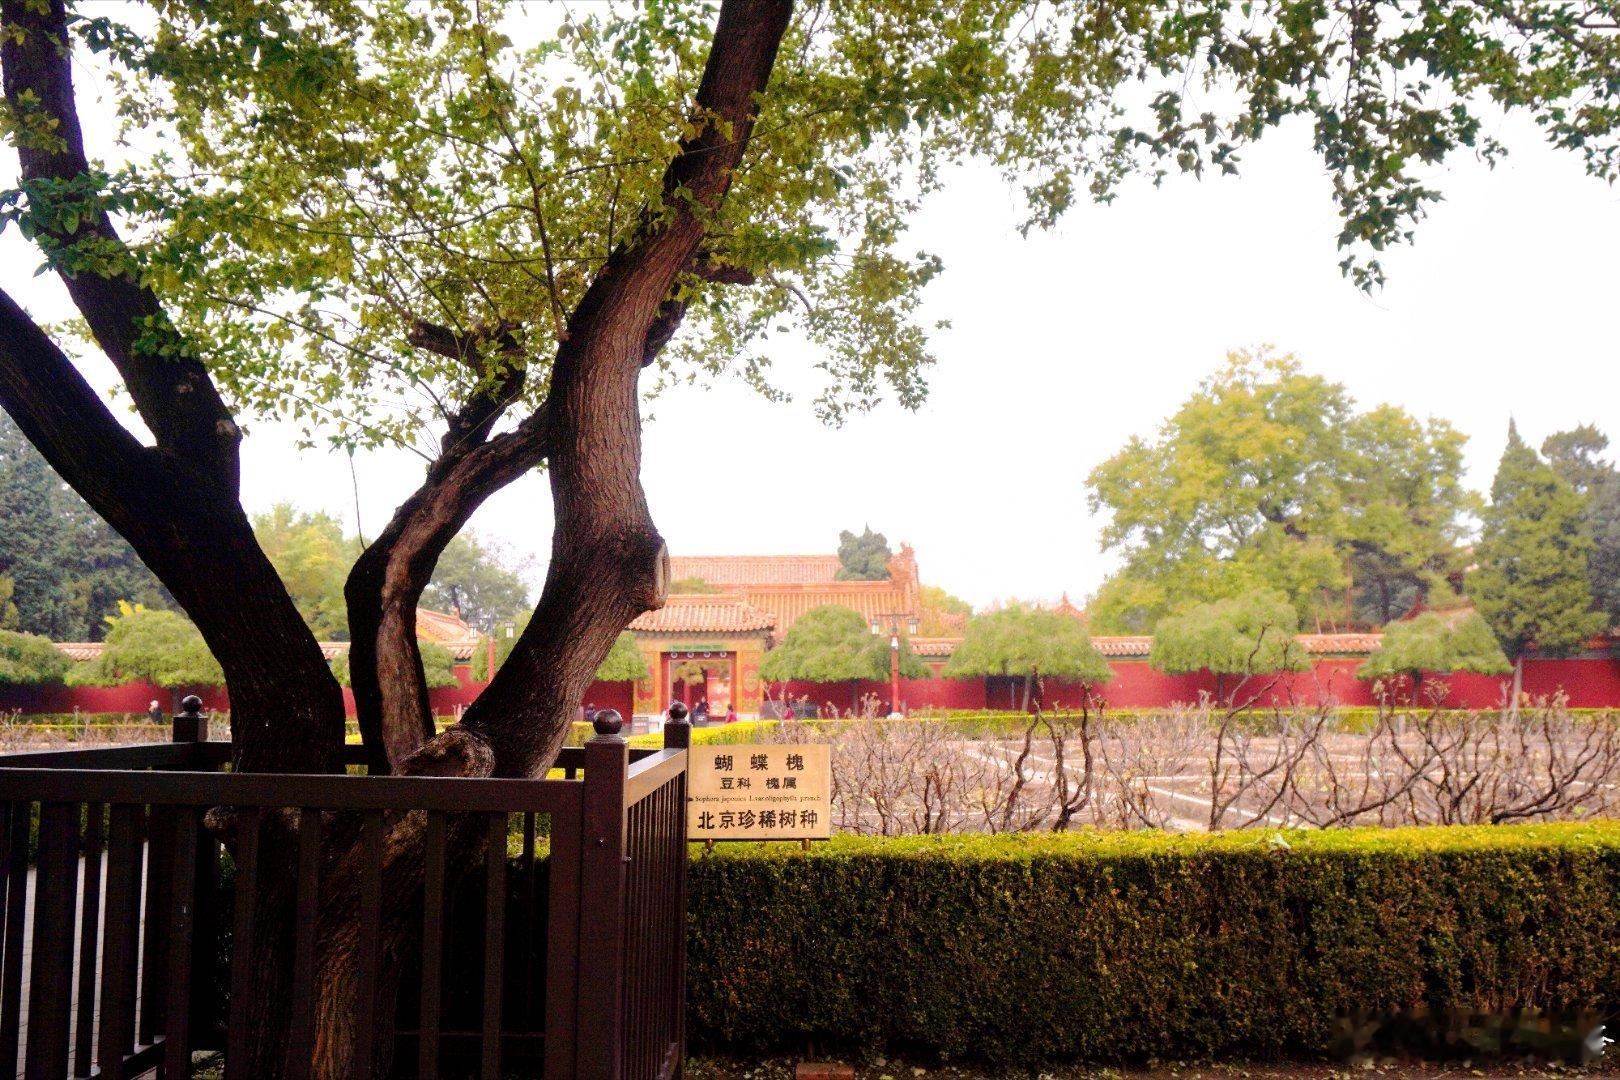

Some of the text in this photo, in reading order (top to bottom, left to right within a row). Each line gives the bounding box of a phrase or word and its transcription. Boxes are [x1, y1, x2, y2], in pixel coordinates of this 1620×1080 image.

[714, 753, 805, 772] 蝴蝶槐
[719, 776, 797, 790] 豆科 槐属
[697, 809, 818, 830] 北京珍稀树种
